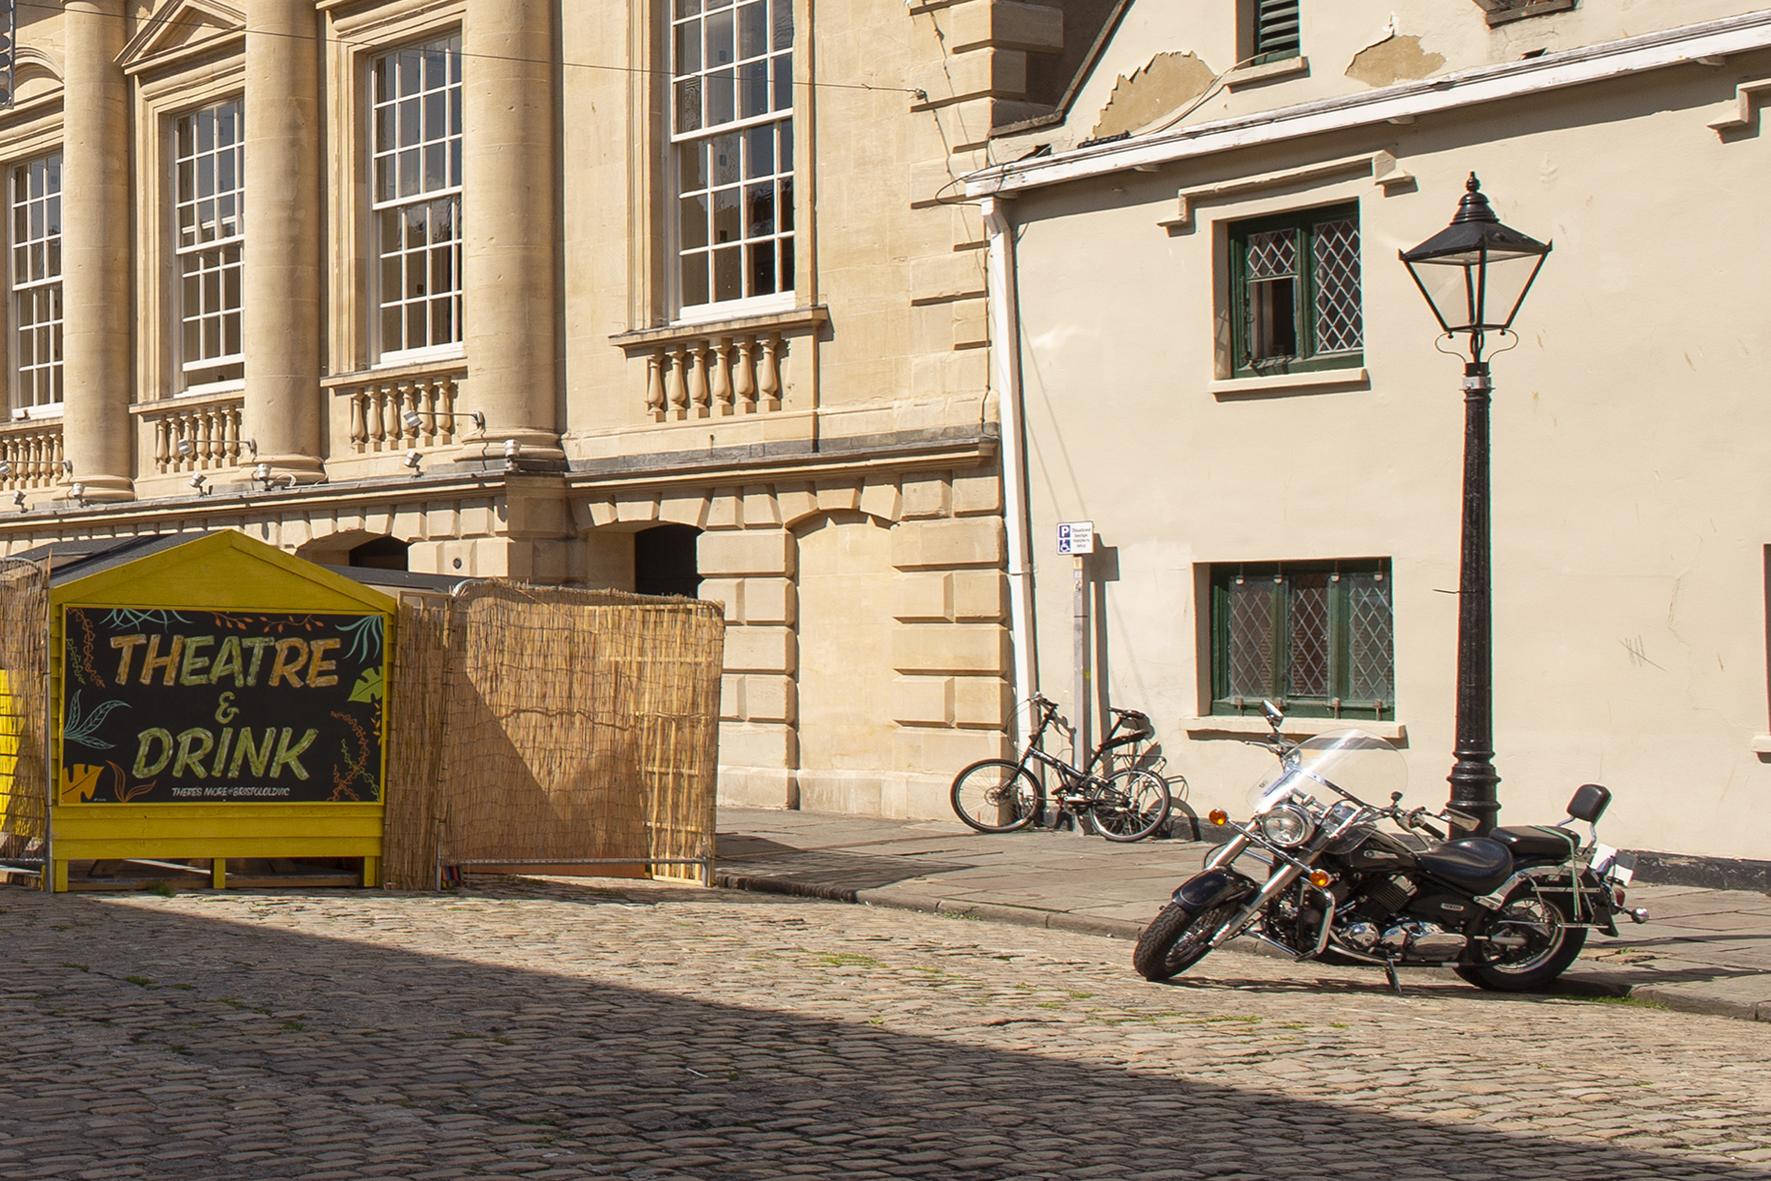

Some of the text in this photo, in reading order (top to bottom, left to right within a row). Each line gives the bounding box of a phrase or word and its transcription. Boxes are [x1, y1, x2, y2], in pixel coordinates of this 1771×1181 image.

[110, 634, 342, 689] THEATRE
[215, 691, 240, 724] &
[132, 727, 319, 781] DRINK
[204, 786, 228, 797] MORE
